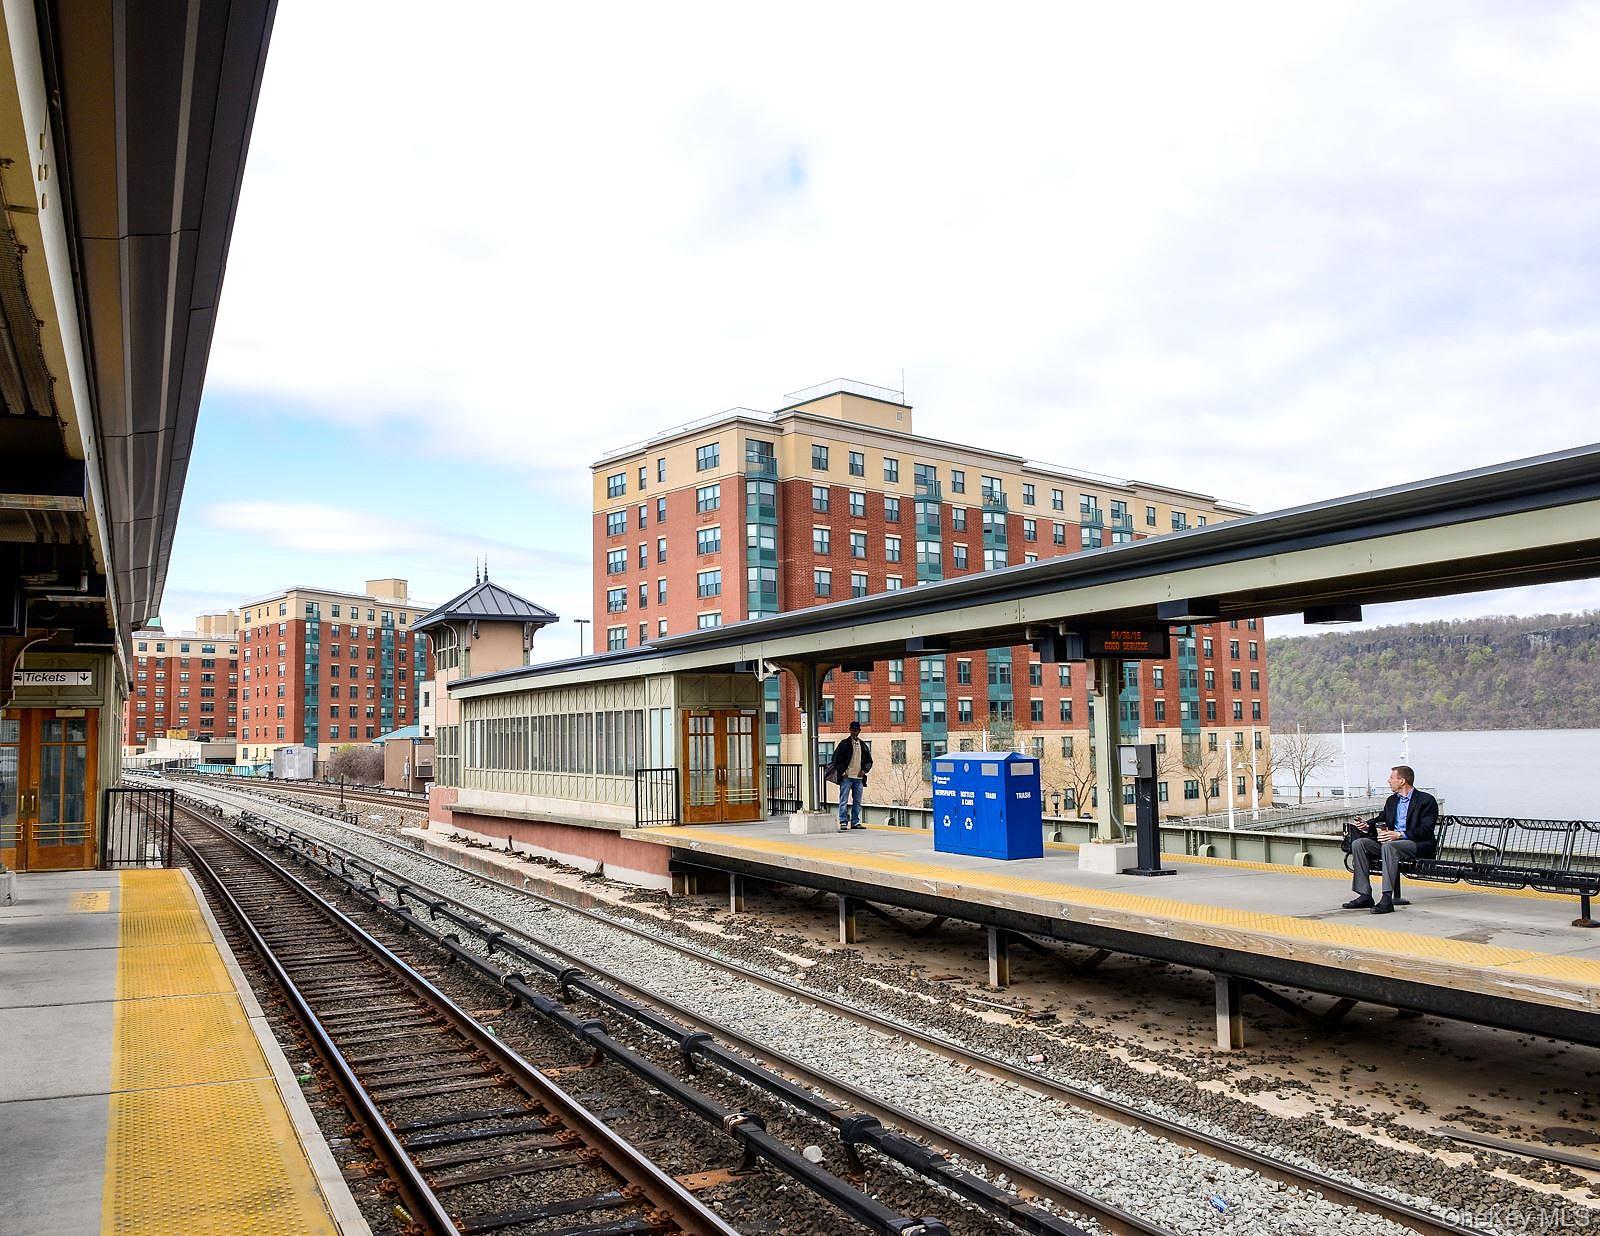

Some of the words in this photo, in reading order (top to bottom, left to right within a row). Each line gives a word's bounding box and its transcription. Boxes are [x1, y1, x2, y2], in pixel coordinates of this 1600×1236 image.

[1104, 641, 1120, 650] GOOD
[1122, 641, 1149, 650] SERVICE
[25, 672, 66, 682] Tickets
[934, 789, 957, 797] NEWSPAPER
[1015, 791, 1031, 799] TRASH
